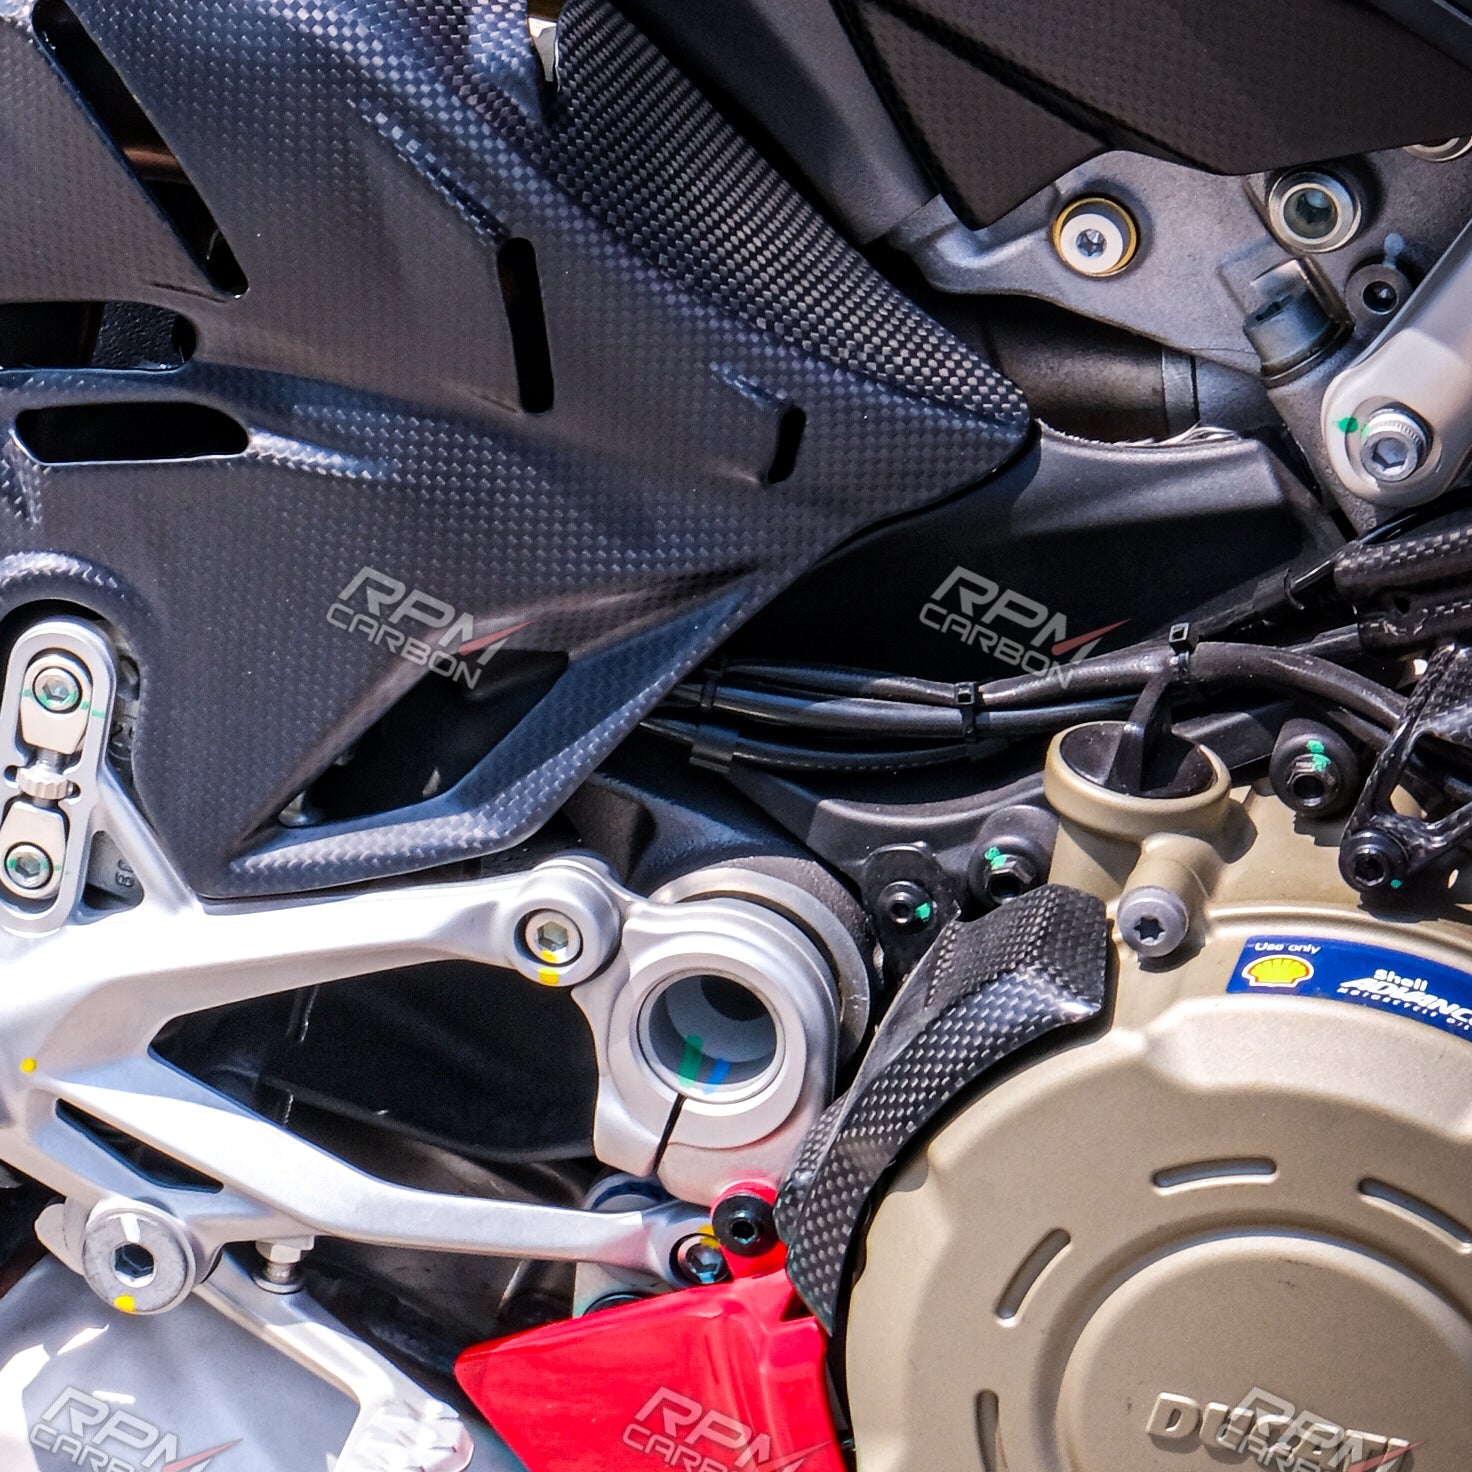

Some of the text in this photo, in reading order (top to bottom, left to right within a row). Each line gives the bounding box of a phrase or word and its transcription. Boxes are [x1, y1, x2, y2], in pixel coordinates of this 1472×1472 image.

[1254, 941, 1322, 955] Use only
[1373, 969, 1428, 992] Shell
[1339, 977, 1472, 1028] ADVANC
